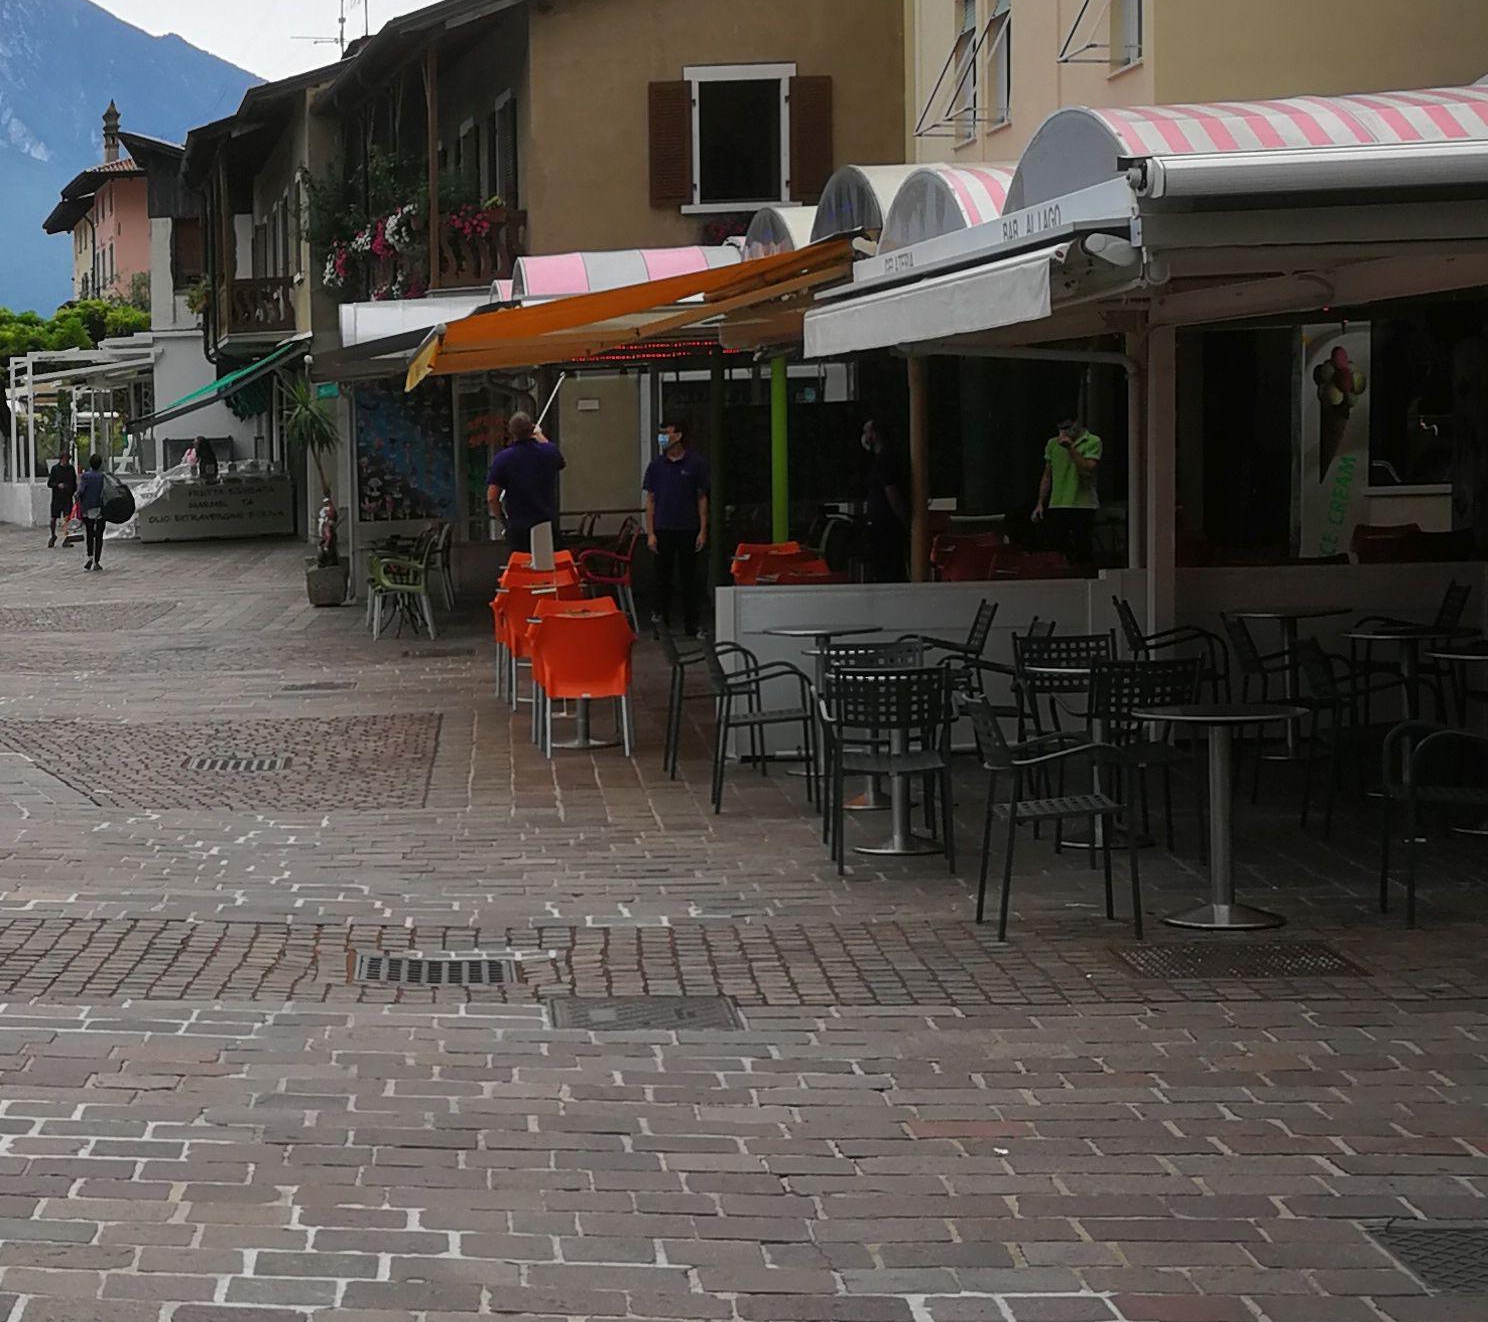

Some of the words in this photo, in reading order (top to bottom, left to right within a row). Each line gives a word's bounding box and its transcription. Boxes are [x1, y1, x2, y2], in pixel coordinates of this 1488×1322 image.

[1002, 218, 1019, 242] BAR
[1327, 454, 1357, 526] CREAM
[148, 514, 171, 524] OLIO
